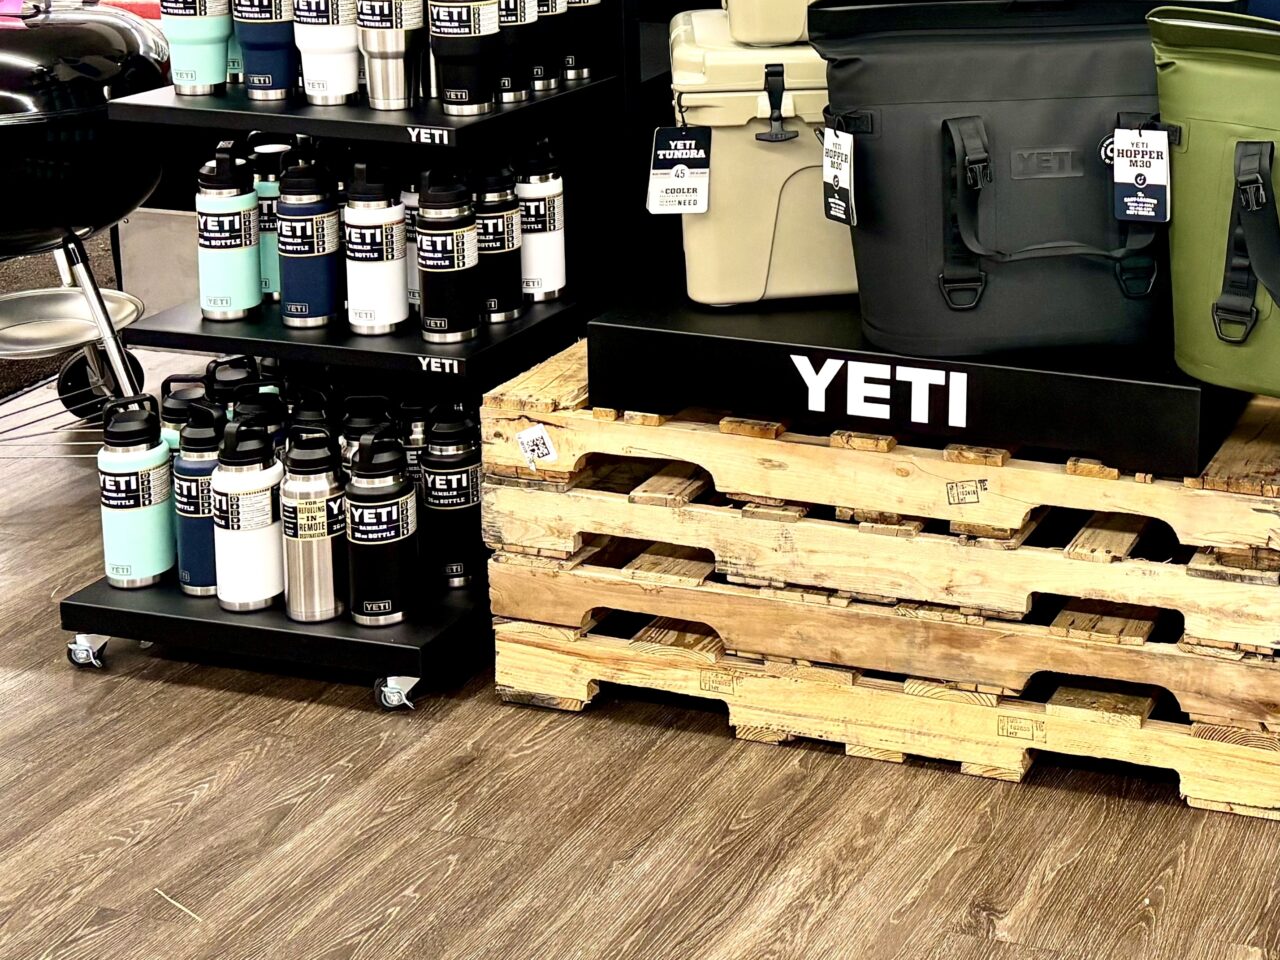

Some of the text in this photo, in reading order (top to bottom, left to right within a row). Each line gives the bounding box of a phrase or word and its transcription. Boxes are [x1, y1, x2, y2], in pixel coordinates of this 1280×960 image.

[356, 0, 390, 14] YETI
[431, 6, 467, 20] YETI
[250, 76, 269, 84] YETI
[307, 81, 326, 89] YETI
[446, 91, 466, 100] YETI
[407, 127, 448, 144] YETI
[669, 140, 696, 149] YETI
[657, 149, 706, 159] TUNDRA
[825, 148, 848, 163] HOPPER
[1117, 149, 1164, 160] HOPPER
[1016, 152, 1072, 171] YETI
[1129, 160, 1151, 168] M30
[675, 169, 685, 178] 45
[520, 202, 545, 215] ETI
[198, 216, 240, 231] YETI
[277, 221, 312, 236] YETI
[476, 219, 503, 233] ETI
[345, 229, 381, 243] YETI
[417, 234, 453, 250] YETI
[211, 239, 241, 247] BOTTLE
[286, 304, 307, 312] YETI
[354, 311, 373, 319] YETI
[426, 320, 445, 328] YETI
[418, 357, 458, 374] YETI
[790, 354, 968, 429] YETI
[99, 475, 137, 490] YETI
[425, 473, 467, 489] YETI
[175, 481, 196, 496] ETI
[351, 507, 398, 523] YETI
[299, 523, 325, 532] REMOTE
[368, 531, 395, 539] BOTTLE
[110, 566, 129, 574] YETI
[366, 602, 389, 610] YETI
